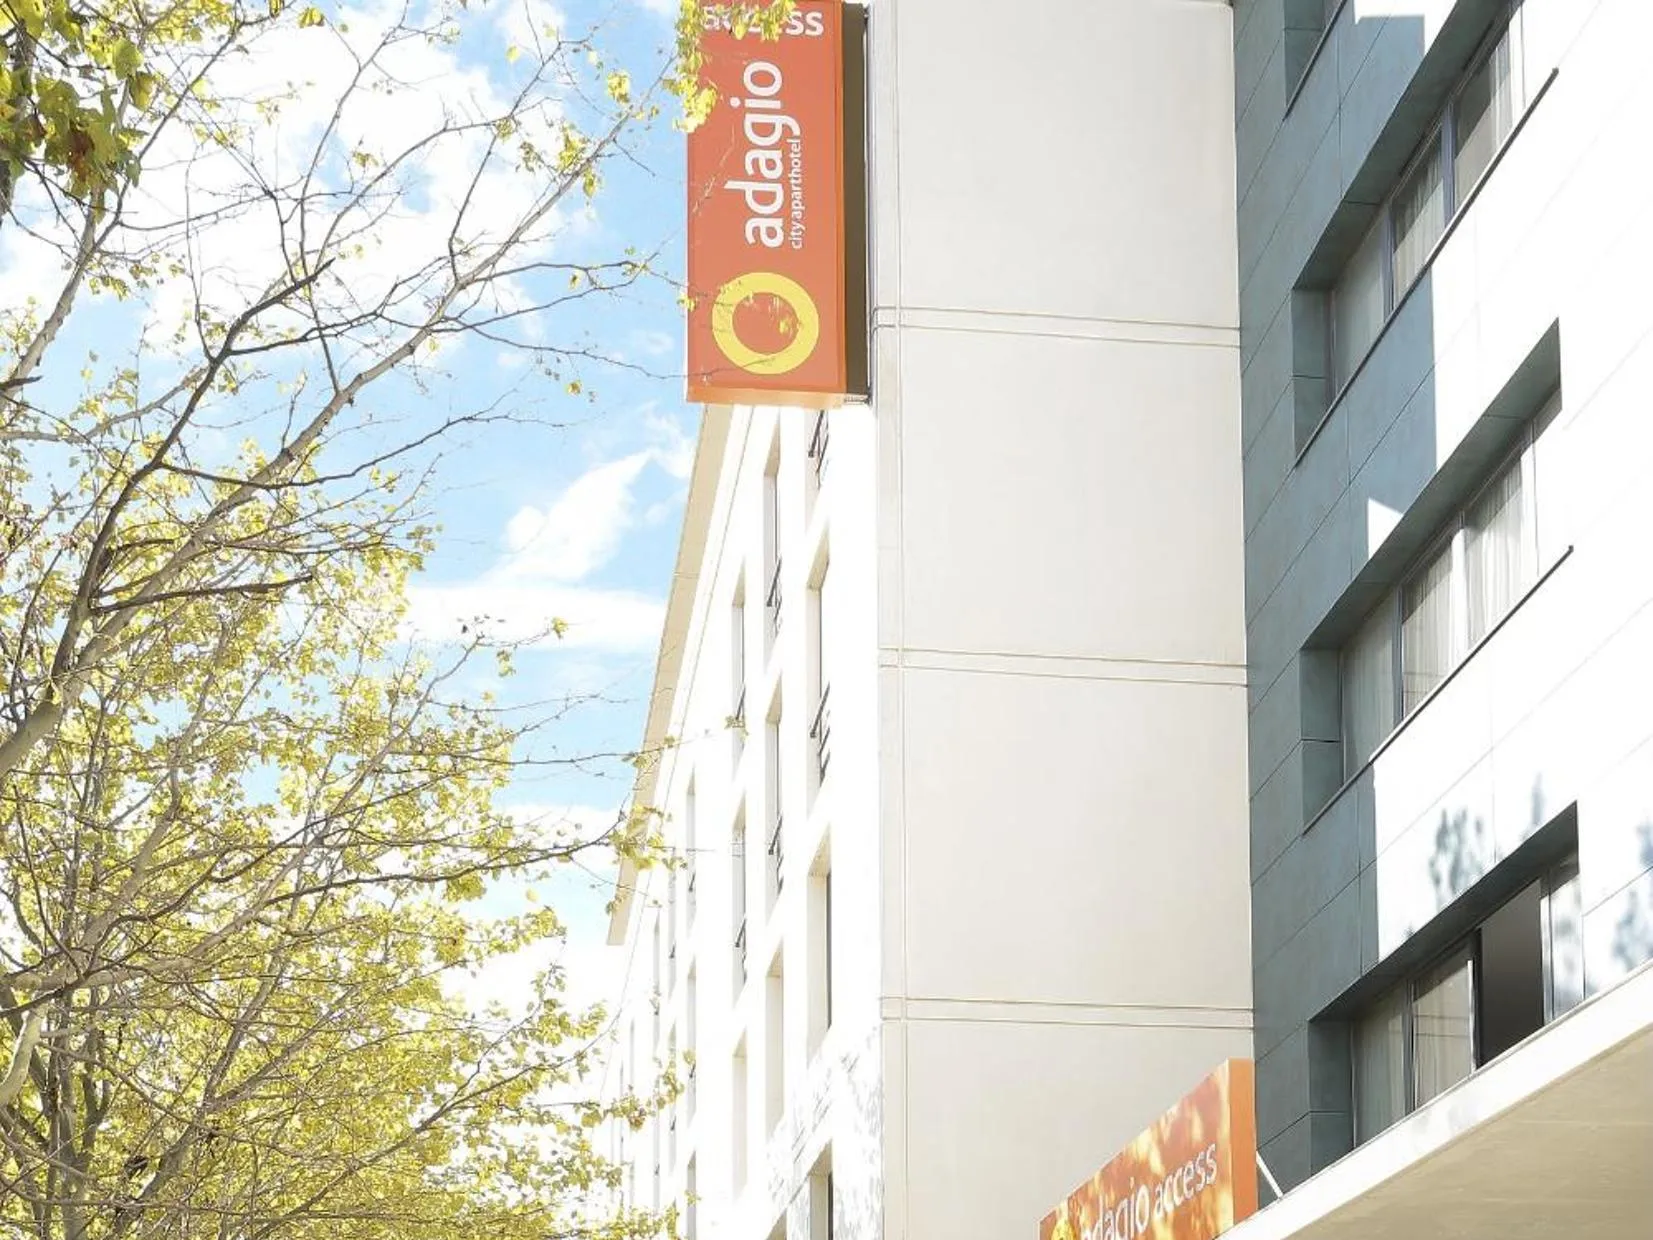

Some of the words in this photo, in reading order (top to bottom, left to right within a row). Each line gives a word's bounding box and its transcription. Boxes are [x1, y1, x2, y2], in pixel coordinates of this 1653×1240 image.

[725, 60, 801, 248] adagio
[787, 138, 805, 219] aparthotel
[788, 220, 806, 249] city
[1153, 1143, 1217, 1218] access
